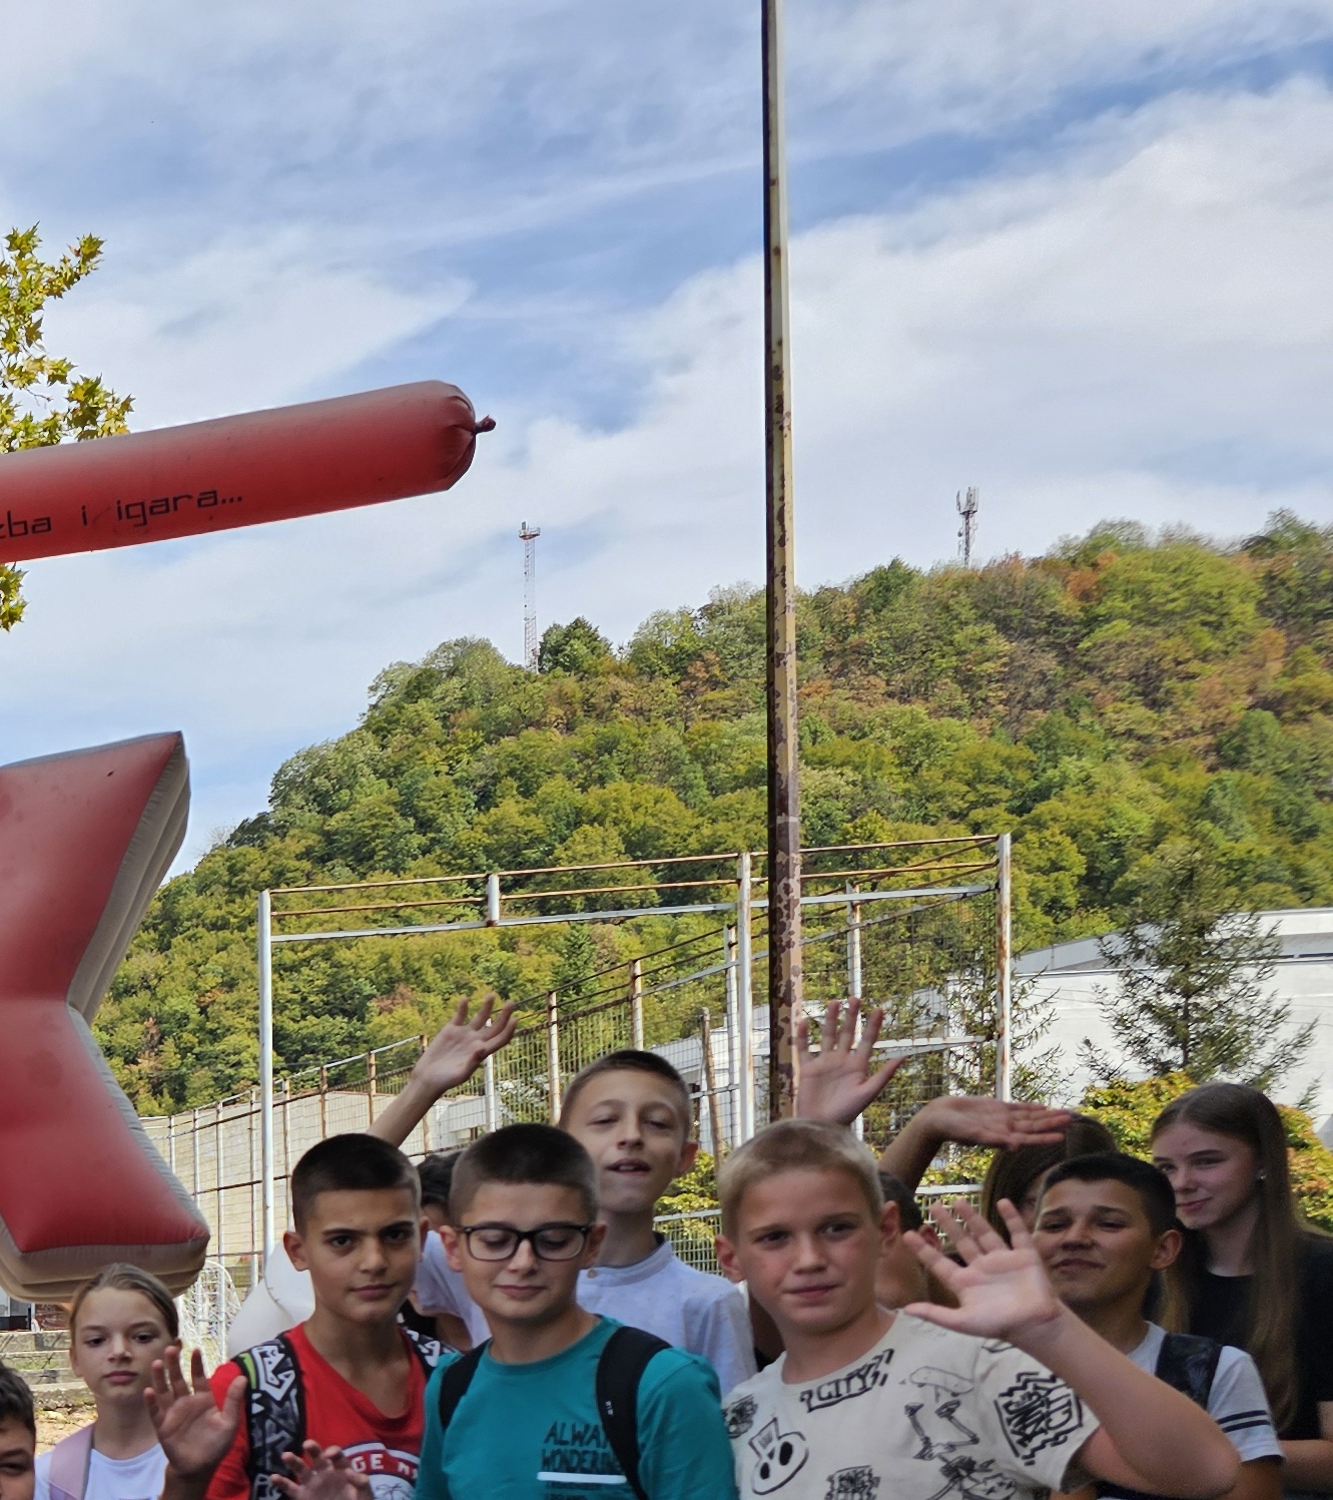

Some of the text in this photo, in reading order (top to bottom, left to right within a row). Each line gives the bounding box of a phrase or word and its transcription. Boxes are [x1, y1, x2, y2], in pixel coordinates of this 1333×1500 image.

[80, 504, 88, 526] i
[116, 488, 243, 528] igara...
[816, 1369, 871, 1403] CITY
[543, 1420, 612, 1450] ALWA
